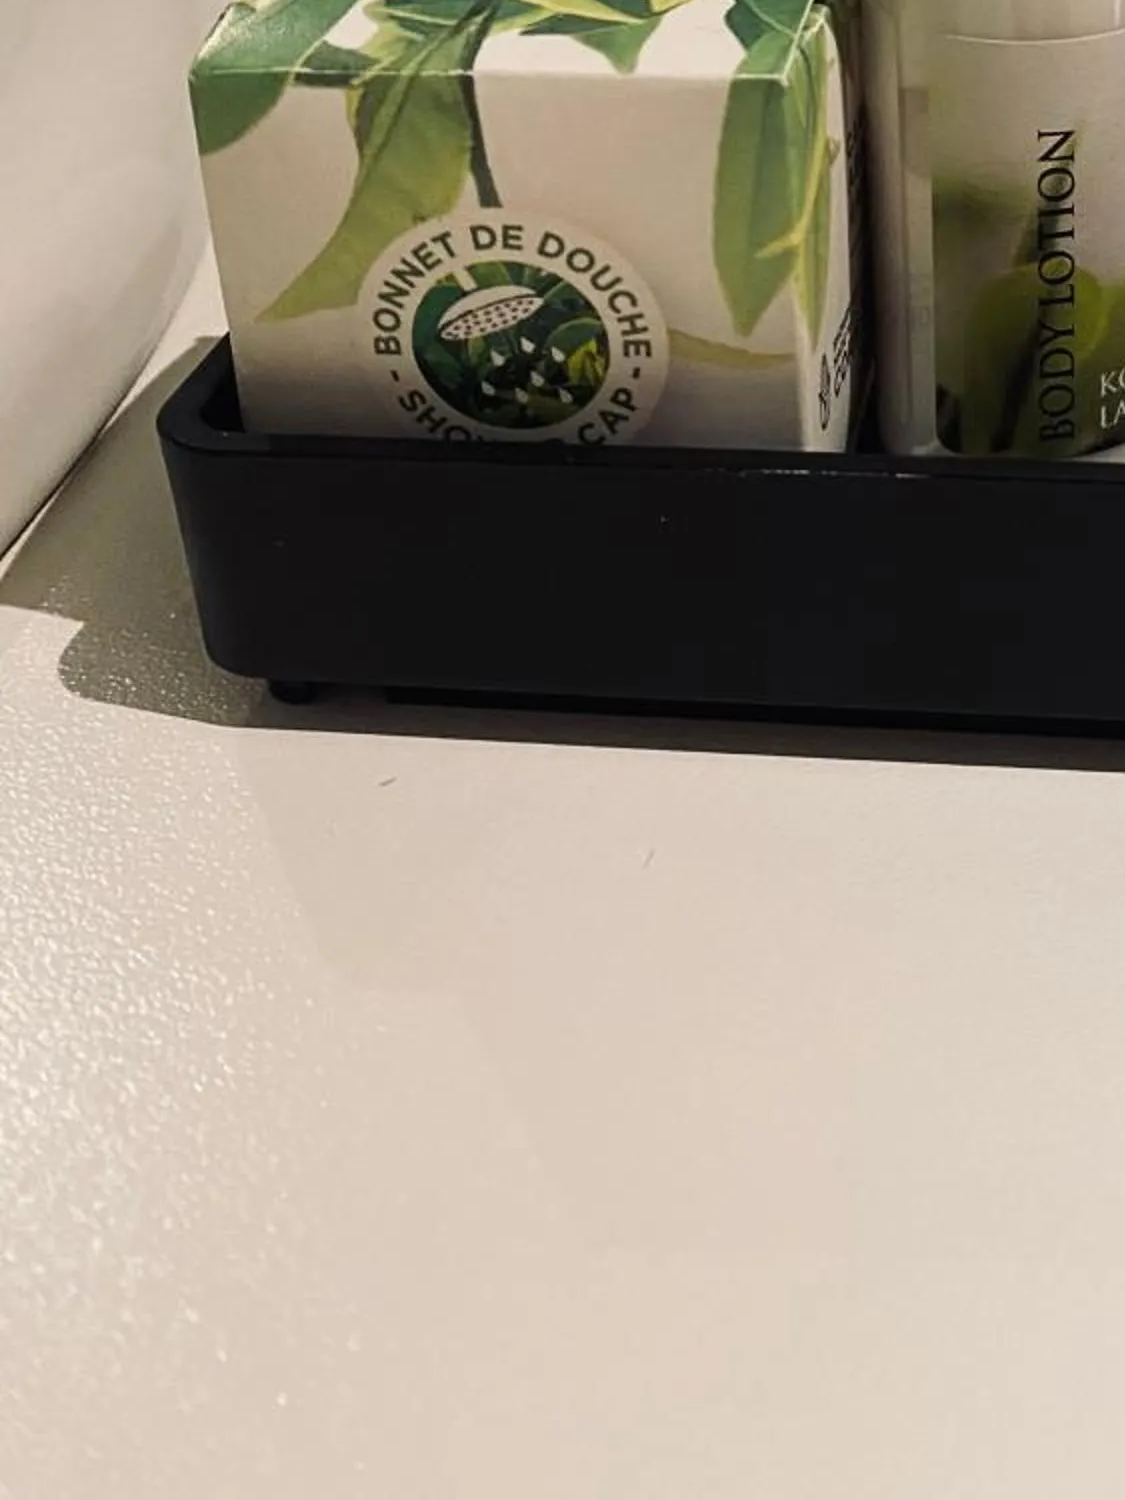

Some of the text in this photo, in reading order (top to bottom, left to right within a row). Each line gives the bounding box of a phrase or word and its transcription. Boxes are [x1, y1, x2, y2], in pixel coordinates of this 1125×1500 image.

[372, 224, 651, 359] BONNET DE DOUCHE
[1037, 129, 1076, 442] BODY LOTION
[577, 387, 638, 446] CAP
